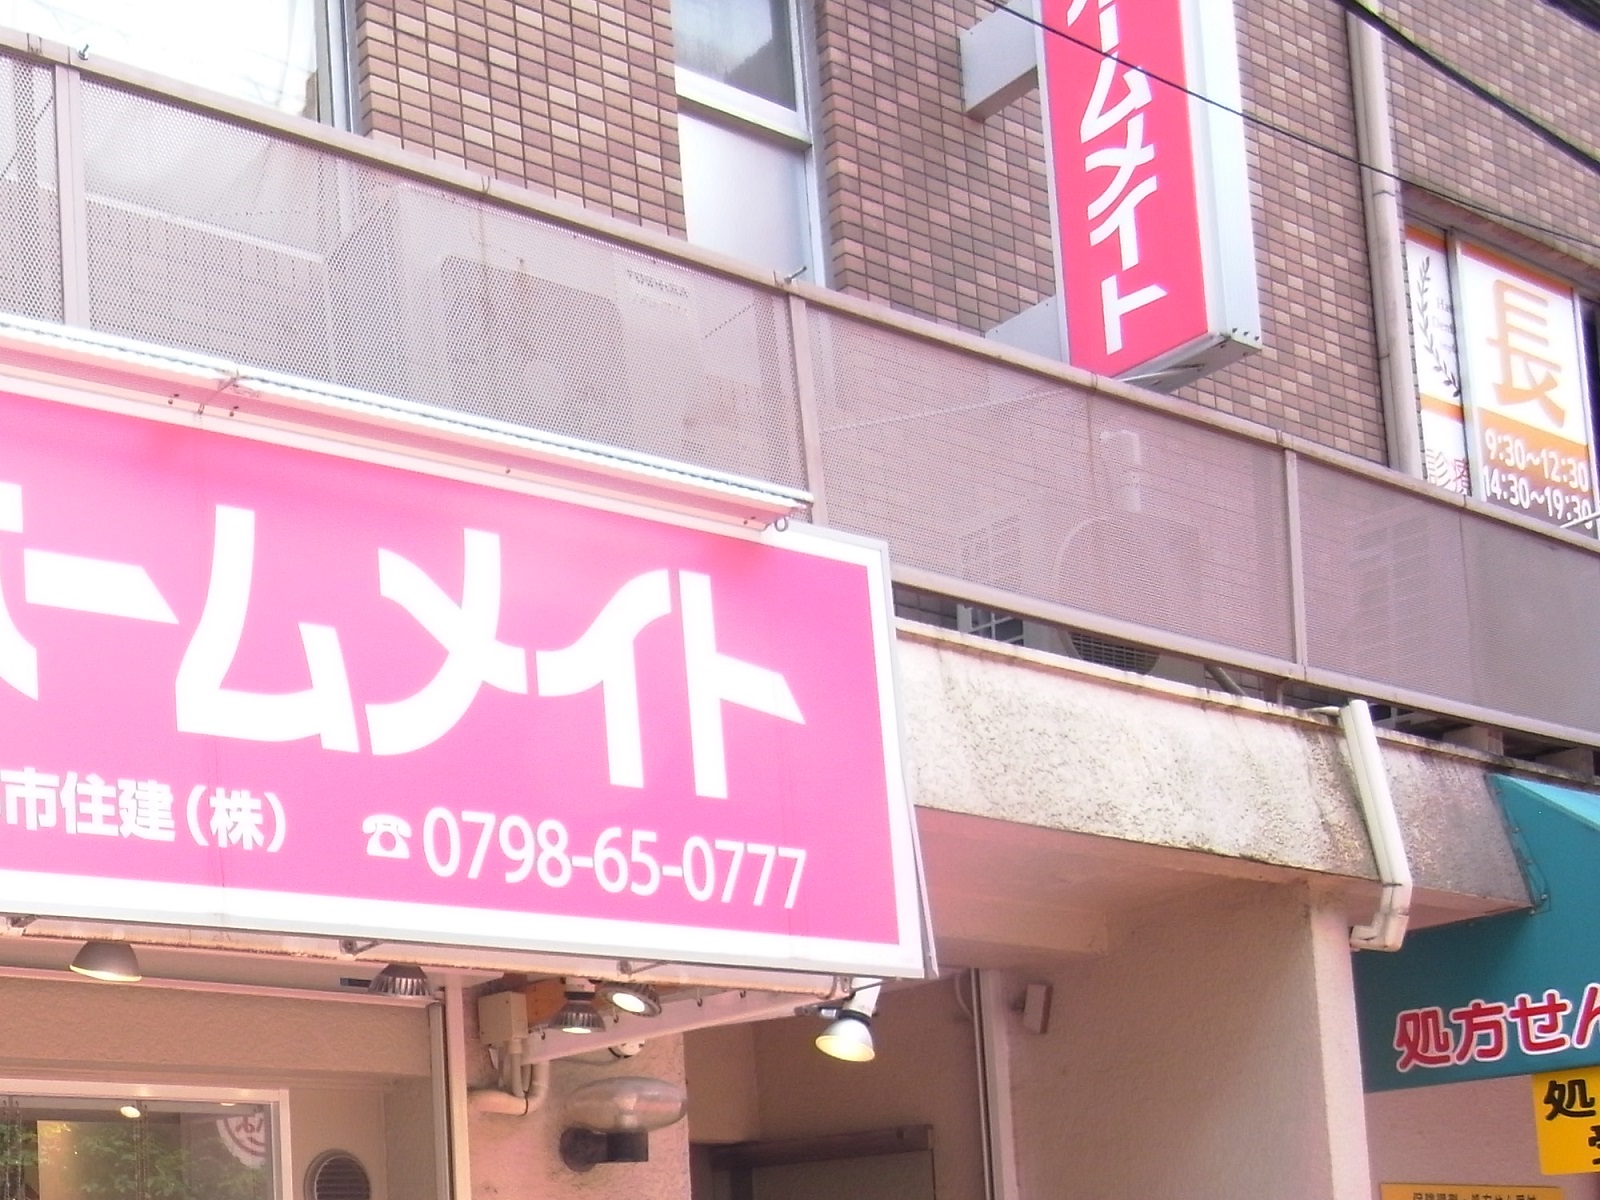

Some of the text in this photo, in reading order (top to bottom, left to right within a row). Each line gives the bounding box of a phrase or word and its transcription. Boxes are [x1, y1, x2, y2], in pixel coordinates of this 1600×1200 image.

[1066, 0, 1169, 356] ームメイト
[1485, 278, 1566, 429] 長
[422, 806, 807, 911] 0798-65-0777
[1543, 1078, 1596, 1121] 処
